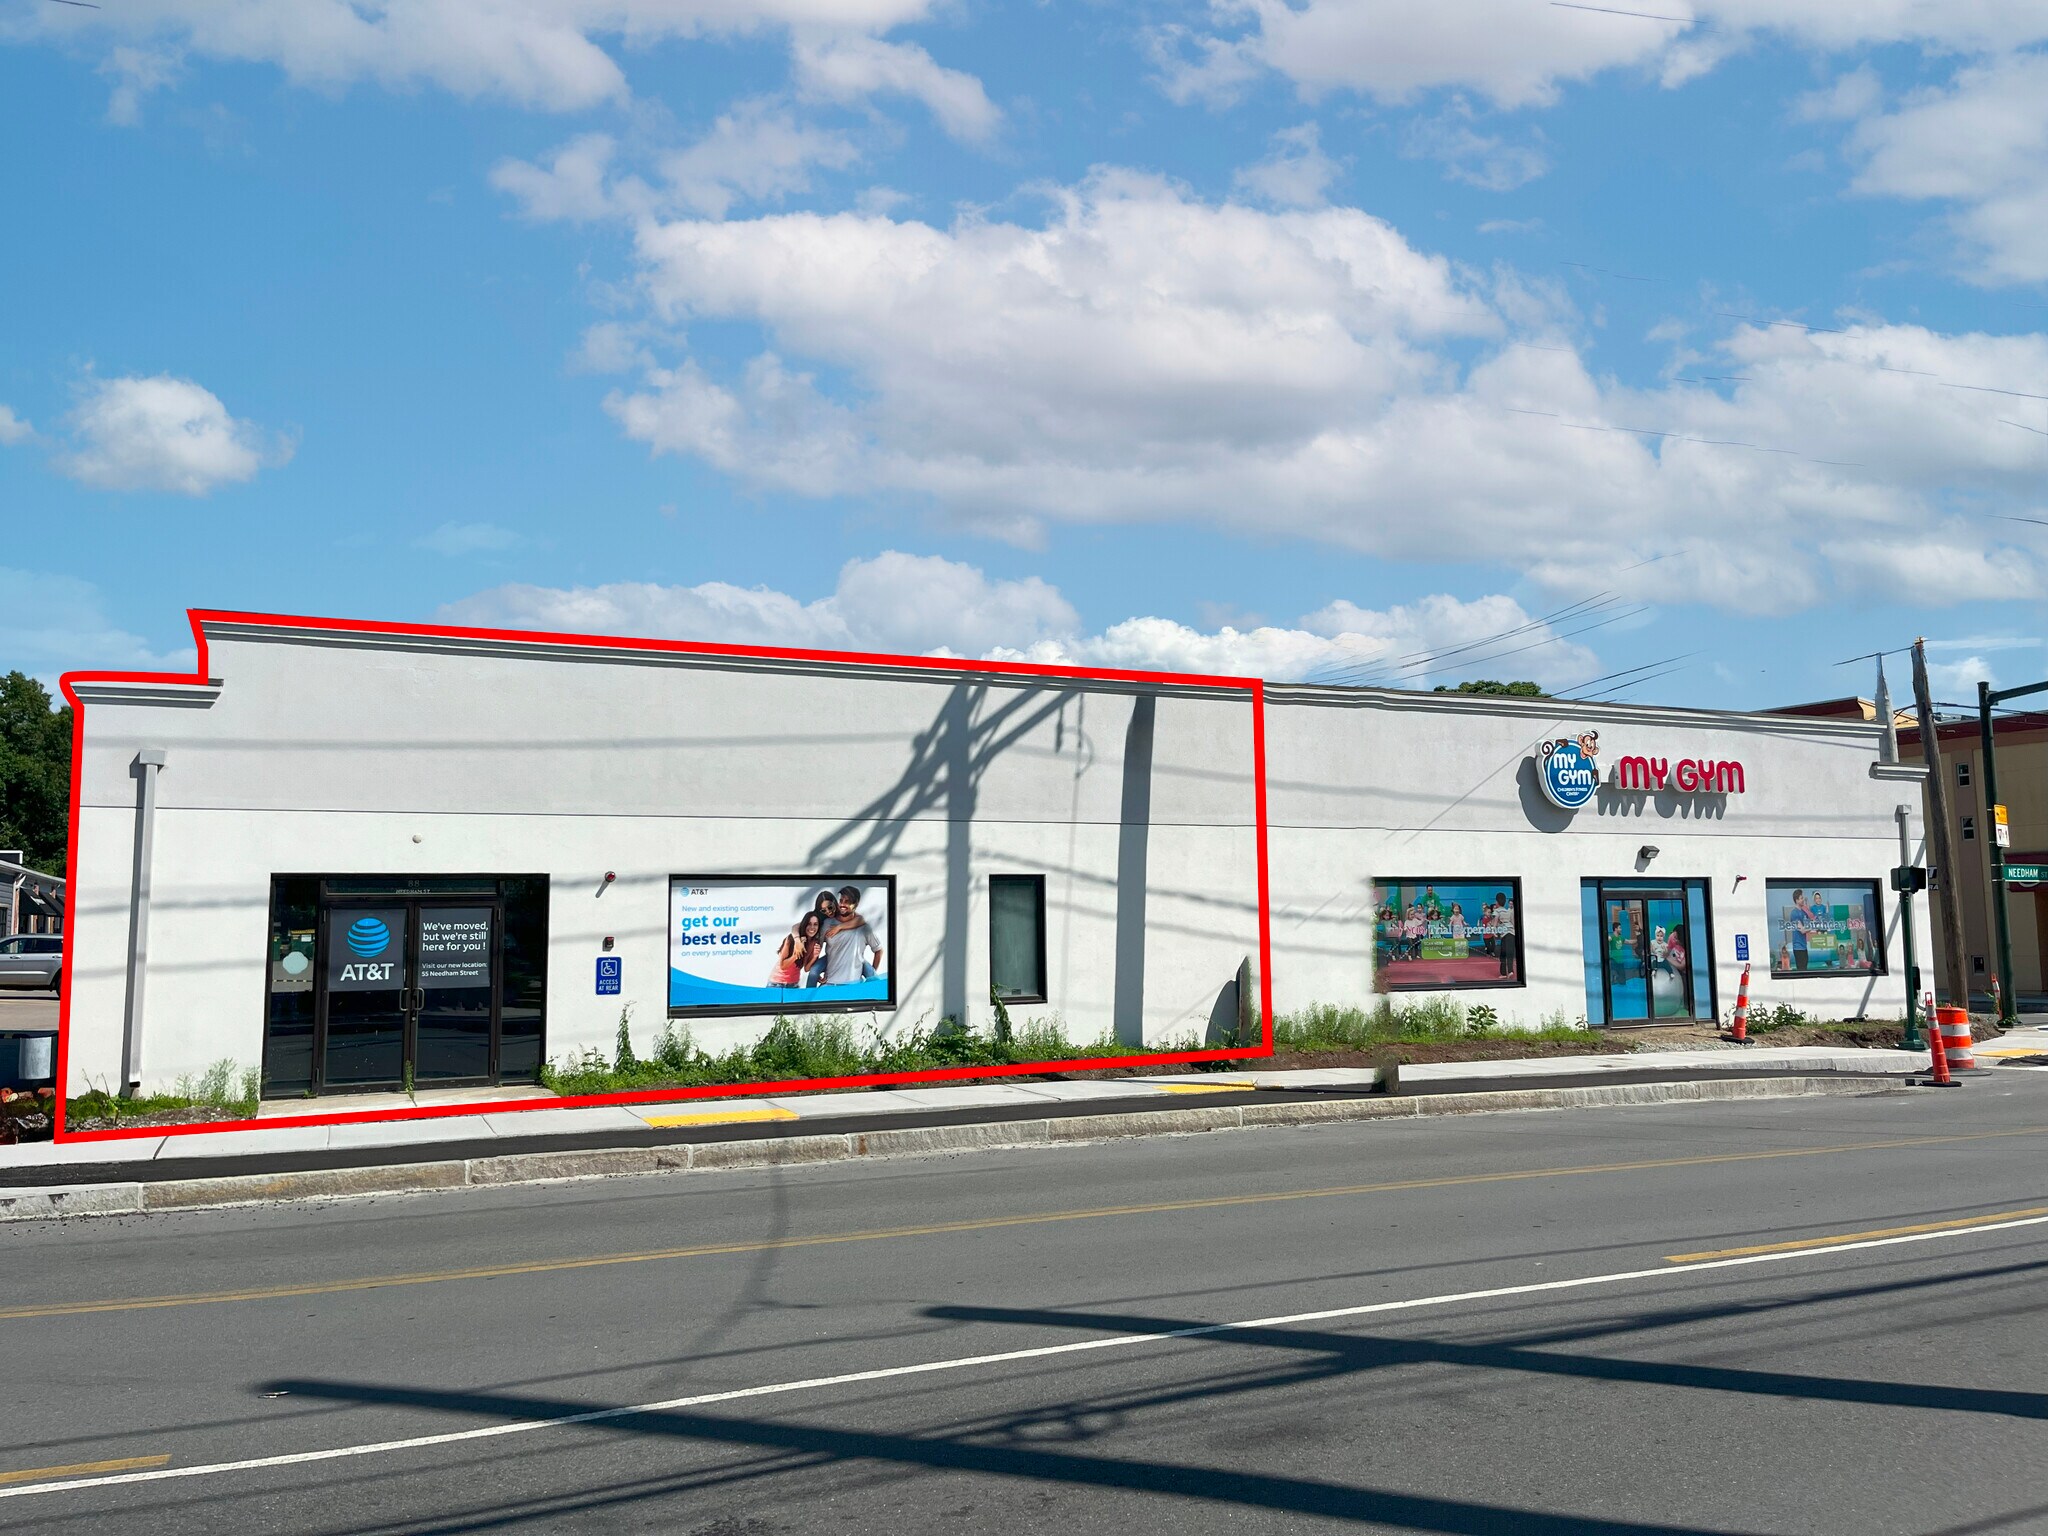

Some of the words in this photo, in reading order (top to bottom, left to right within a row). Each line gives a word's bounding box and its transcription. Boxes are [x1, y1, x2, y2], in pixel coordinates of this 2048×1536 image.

[1554, 753, 1576, 768] MY
[1558, 770, 1591, 785] GYM
[1620, 756, 1668, 790] MY
[1677, 759, 1745, 793] GYM
[2008, 868, 2039, 878] NEEDHAM
[423, 922, 452, 930] We've
[454, 921, 489, 931] moved,
[682, 915, 709, 931] get
[713, 917, 739, 927] our
[1427, 924, 1452, 935] Trial
[423, 932, 440, 941] but
[442, 932, 468, 940] we're
[470, 931, 487, 940] still
[682, 932, 717, 946] best
[721, 931, 762, 944] deals
[423, 942, 445, 951] here
[446, 941, 461, 950] for
[463, 943, 481, 952] you
[712, 949, 752, 957] smartphone
[340, 963, 394, 981] AT&T
